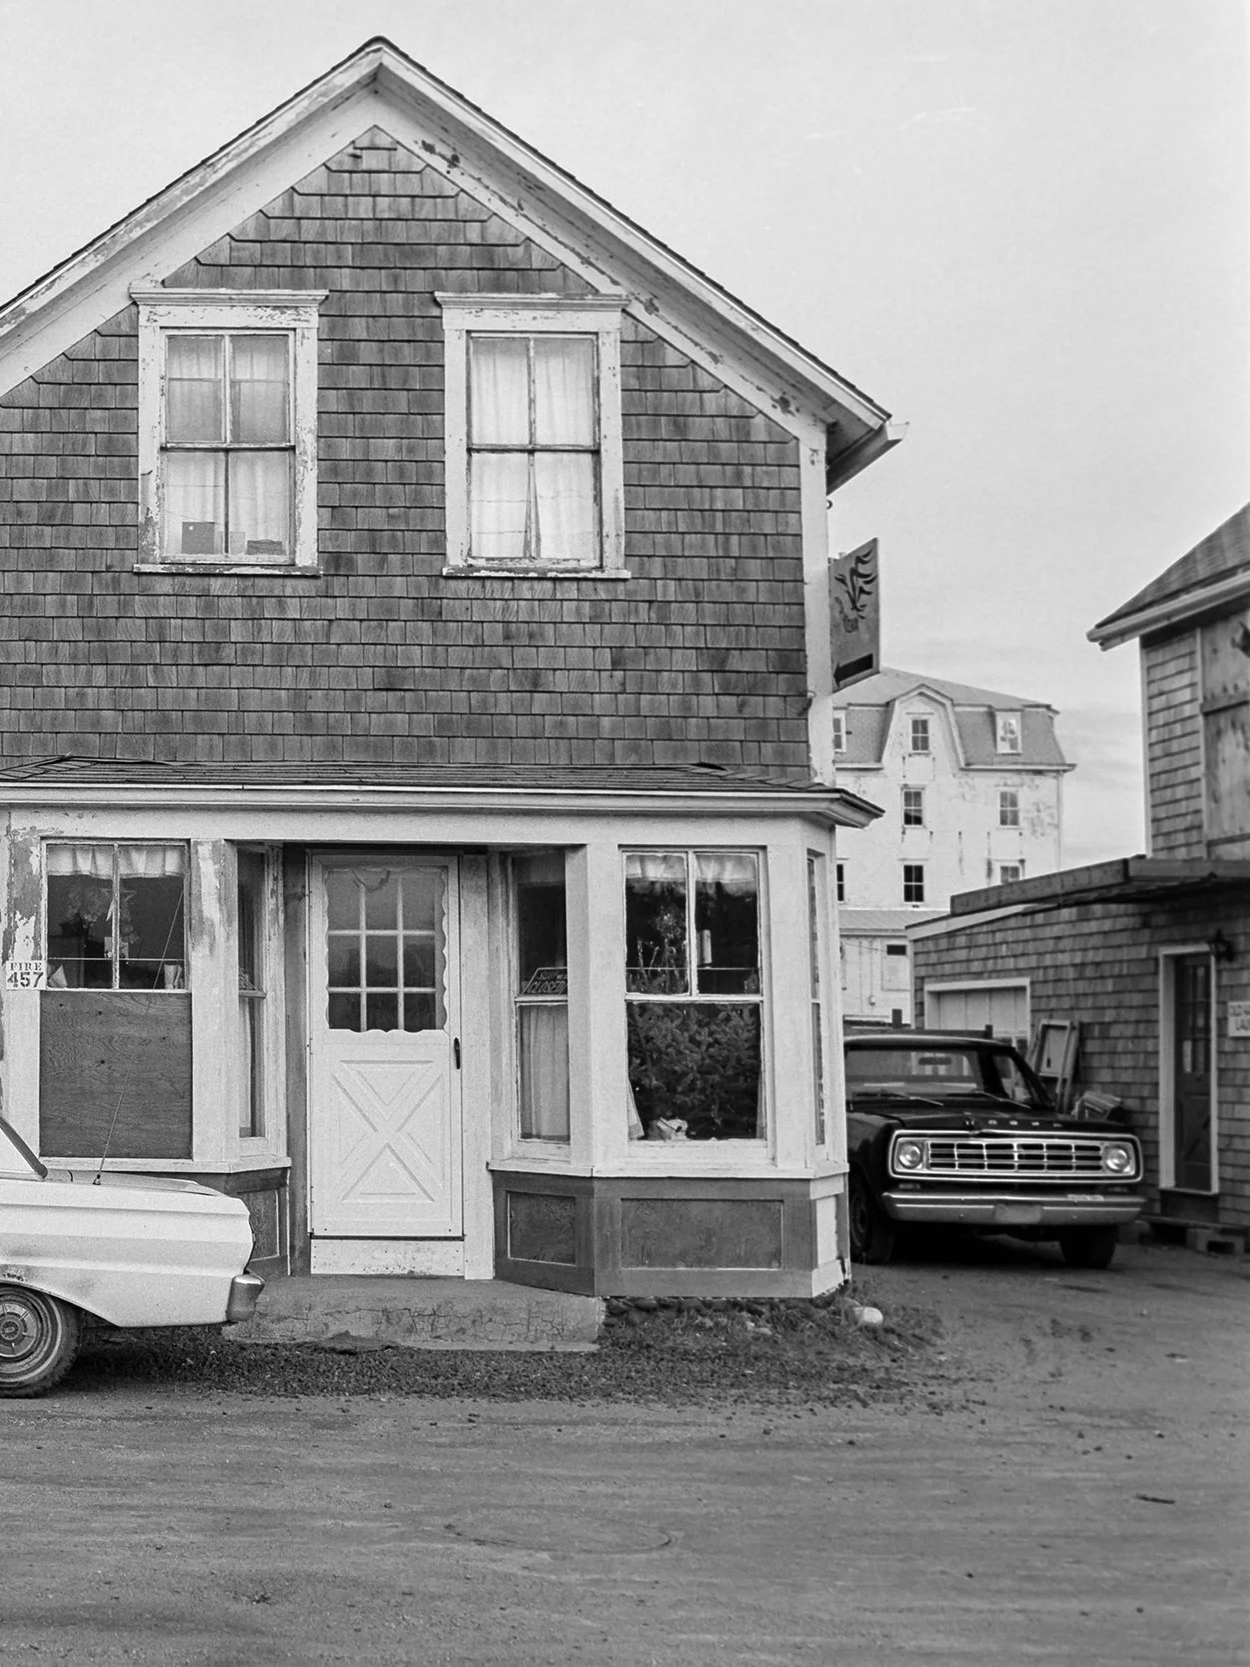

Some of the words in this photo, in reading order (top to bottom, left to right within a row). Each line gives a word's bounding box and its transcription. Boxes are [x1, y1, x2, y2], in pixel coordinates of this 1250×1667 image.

[10, 962, 42, 971] FIRE
[7, 971, 44, 988] 457
[527, 980, 566, 994] CLOSED
